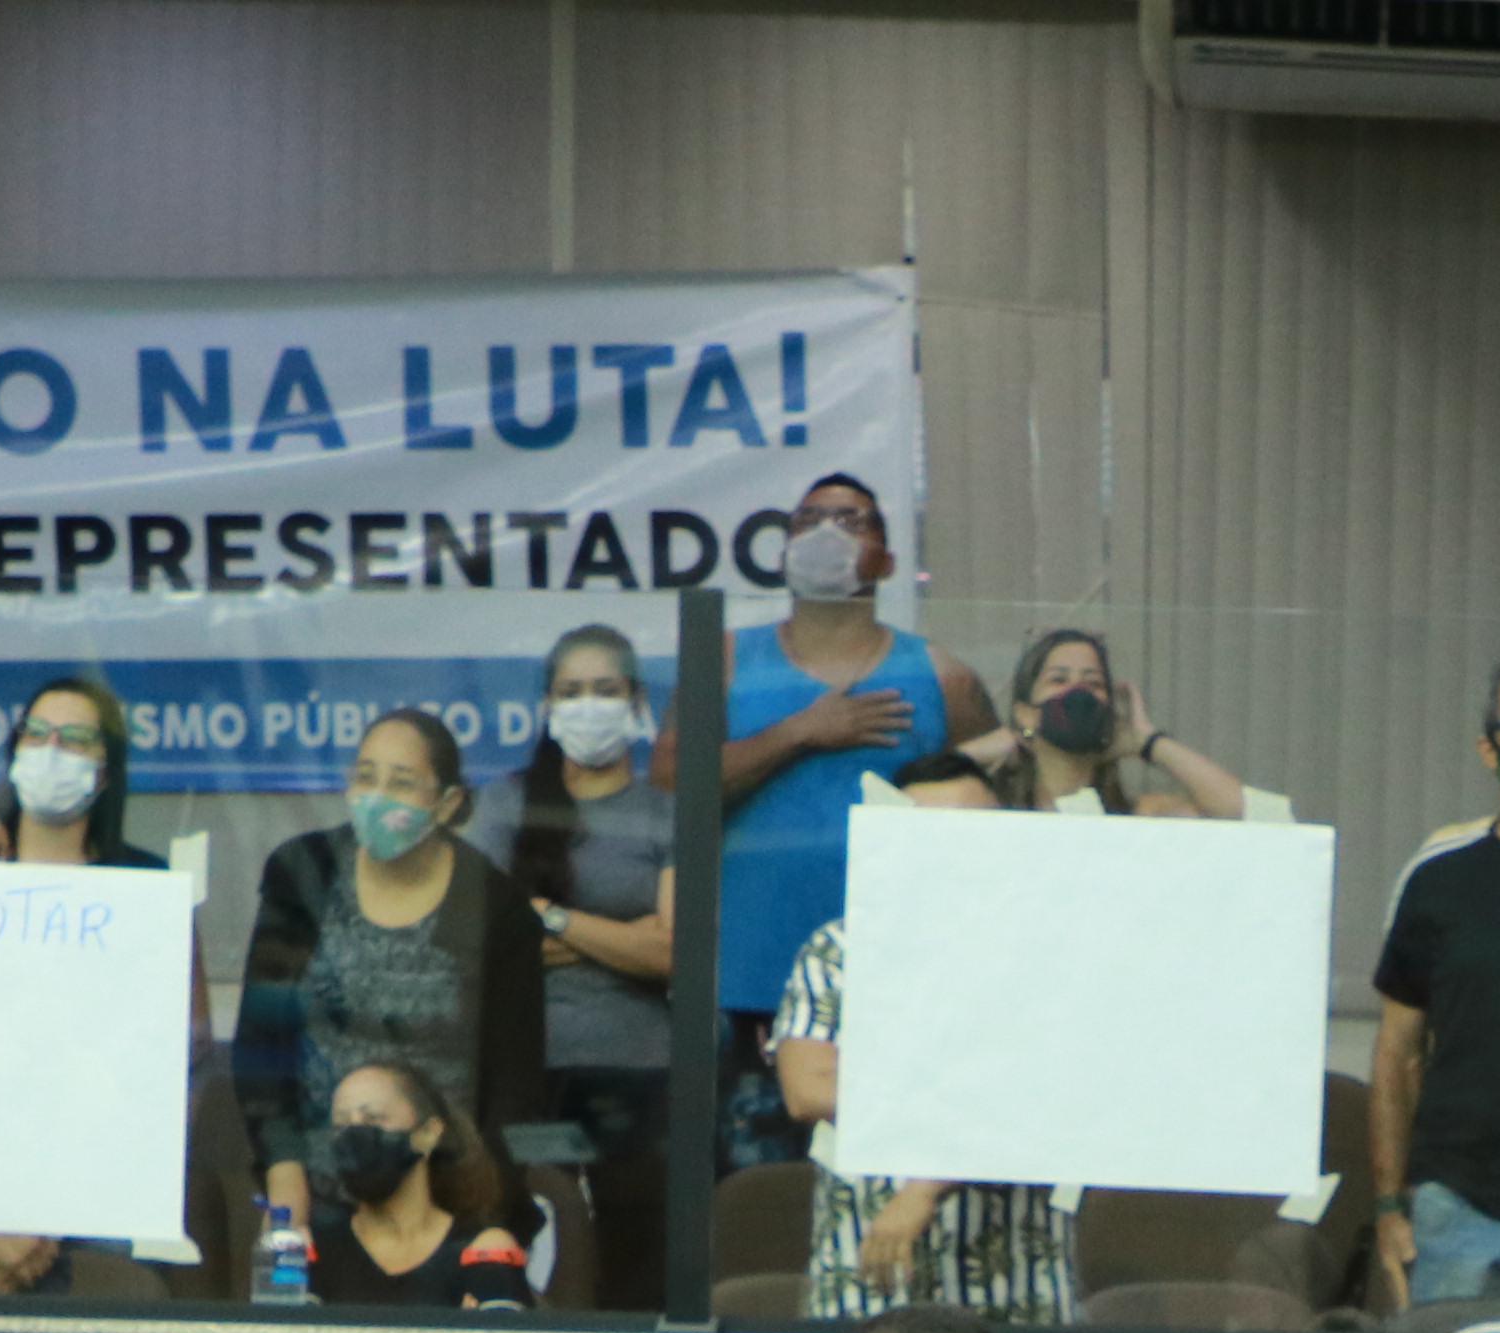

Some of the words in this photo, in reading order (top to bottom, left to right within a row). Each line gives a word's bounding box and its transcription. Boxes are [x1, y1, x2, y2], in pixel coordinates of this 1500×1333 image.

[136, 346, 347, 453] NA
[402, 331, 808, 451] LUTA!
[263, 690, 483, 748] PÚBO
